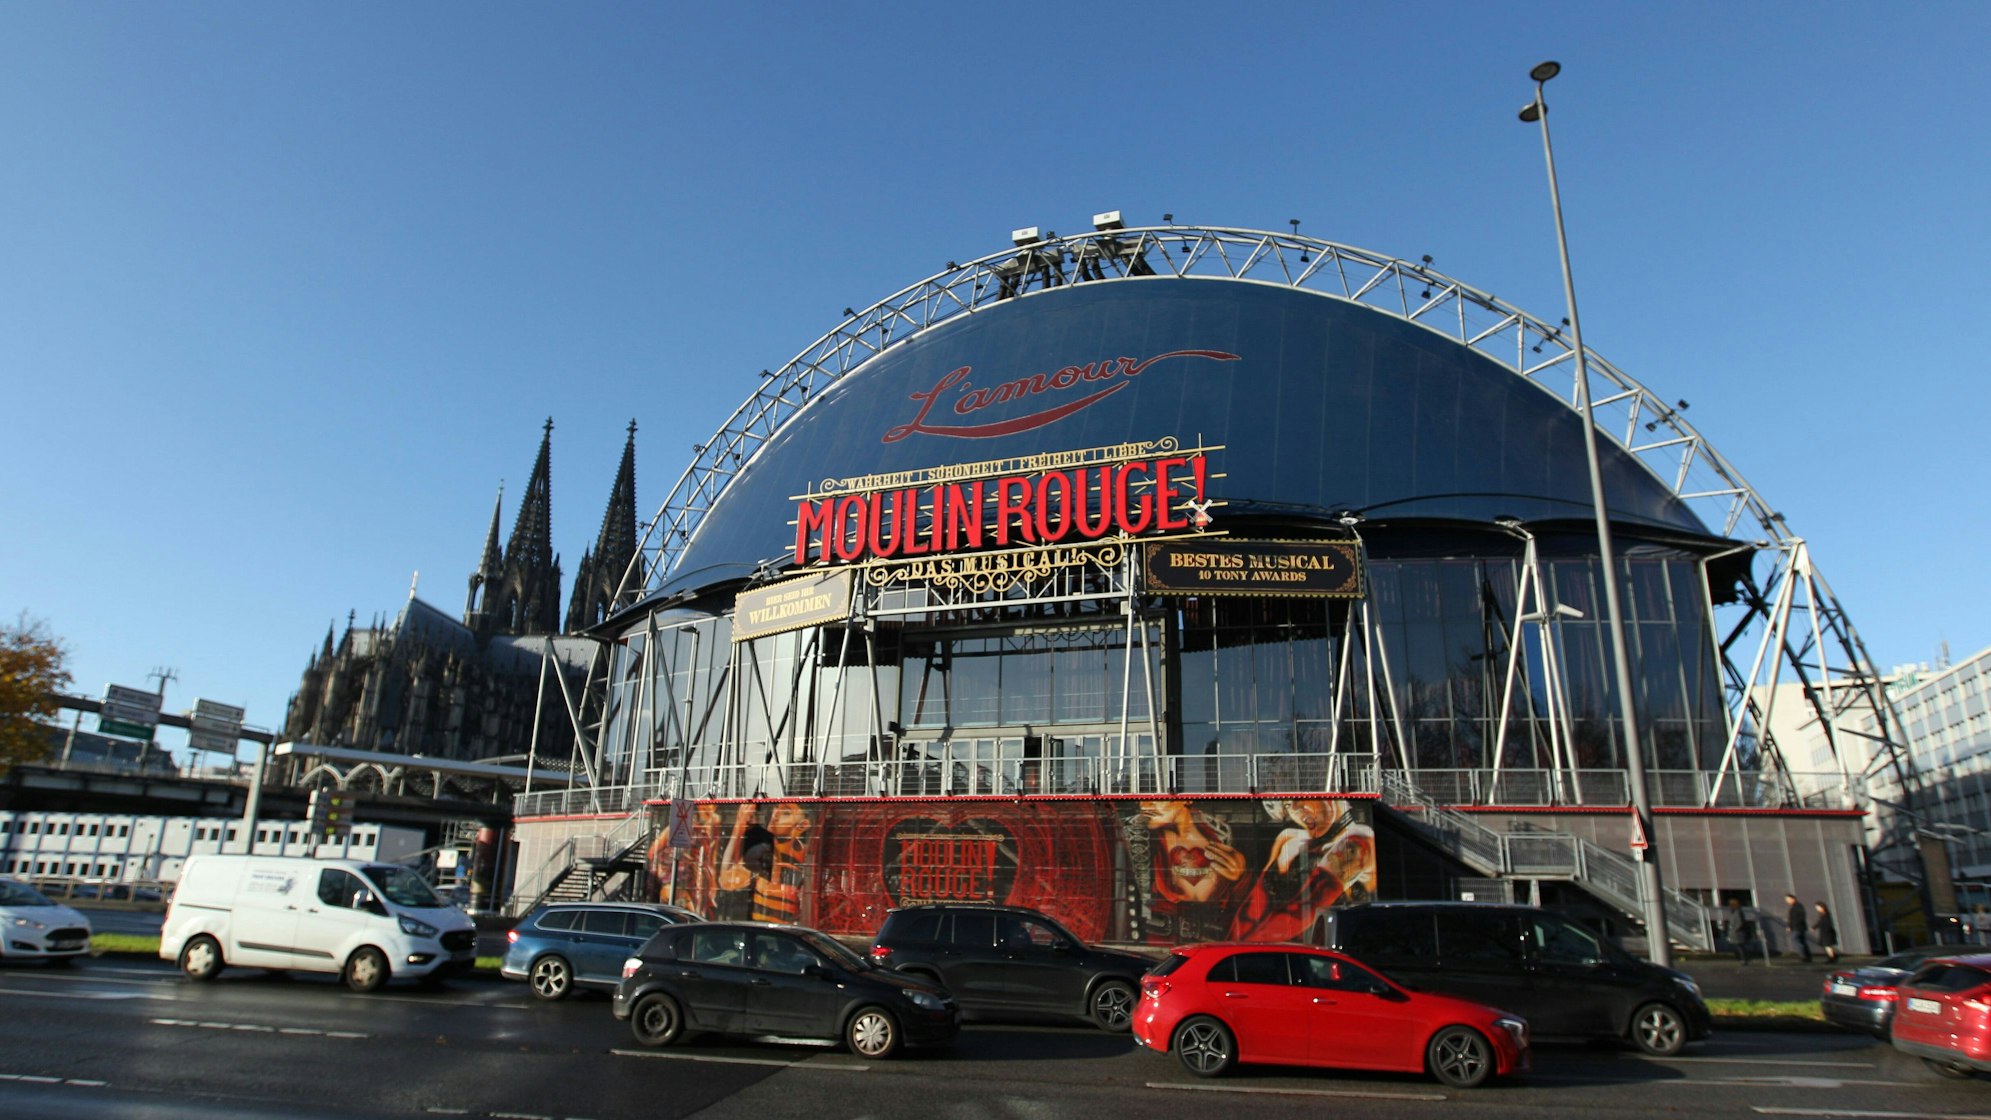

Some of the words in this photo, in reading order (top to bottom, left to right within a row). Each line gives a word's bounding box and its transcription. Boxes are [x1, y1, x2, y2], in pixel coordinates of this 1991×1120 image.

[881, 350, 1241, 443] L'amour
[847, 472, 913, 490] WAHRHEIT
[1020, 450, 1086, 469] FREIHEIT
[1104, 443, 1147, 459] LIEBE
[795, 481, 983, 565] MOULIN
[998, 456, 1208, 546] ROUGE!
[911, 558, 953, 578] DAS
[963, 547, 1079, 575] MUSICAL!
[1169, 553, 1244, 568] BESTES
[1249, 554, 1334, 570] MUSICAL
[1198, 570, 1212, 580] 10
[1214, 570, 1248, 581] TONY
[1251, 571, 1307, 582] AWARDS
[749, 593, 832, 624] WILLKOMMEN
[901, 840, 983, 867] MOULIN
